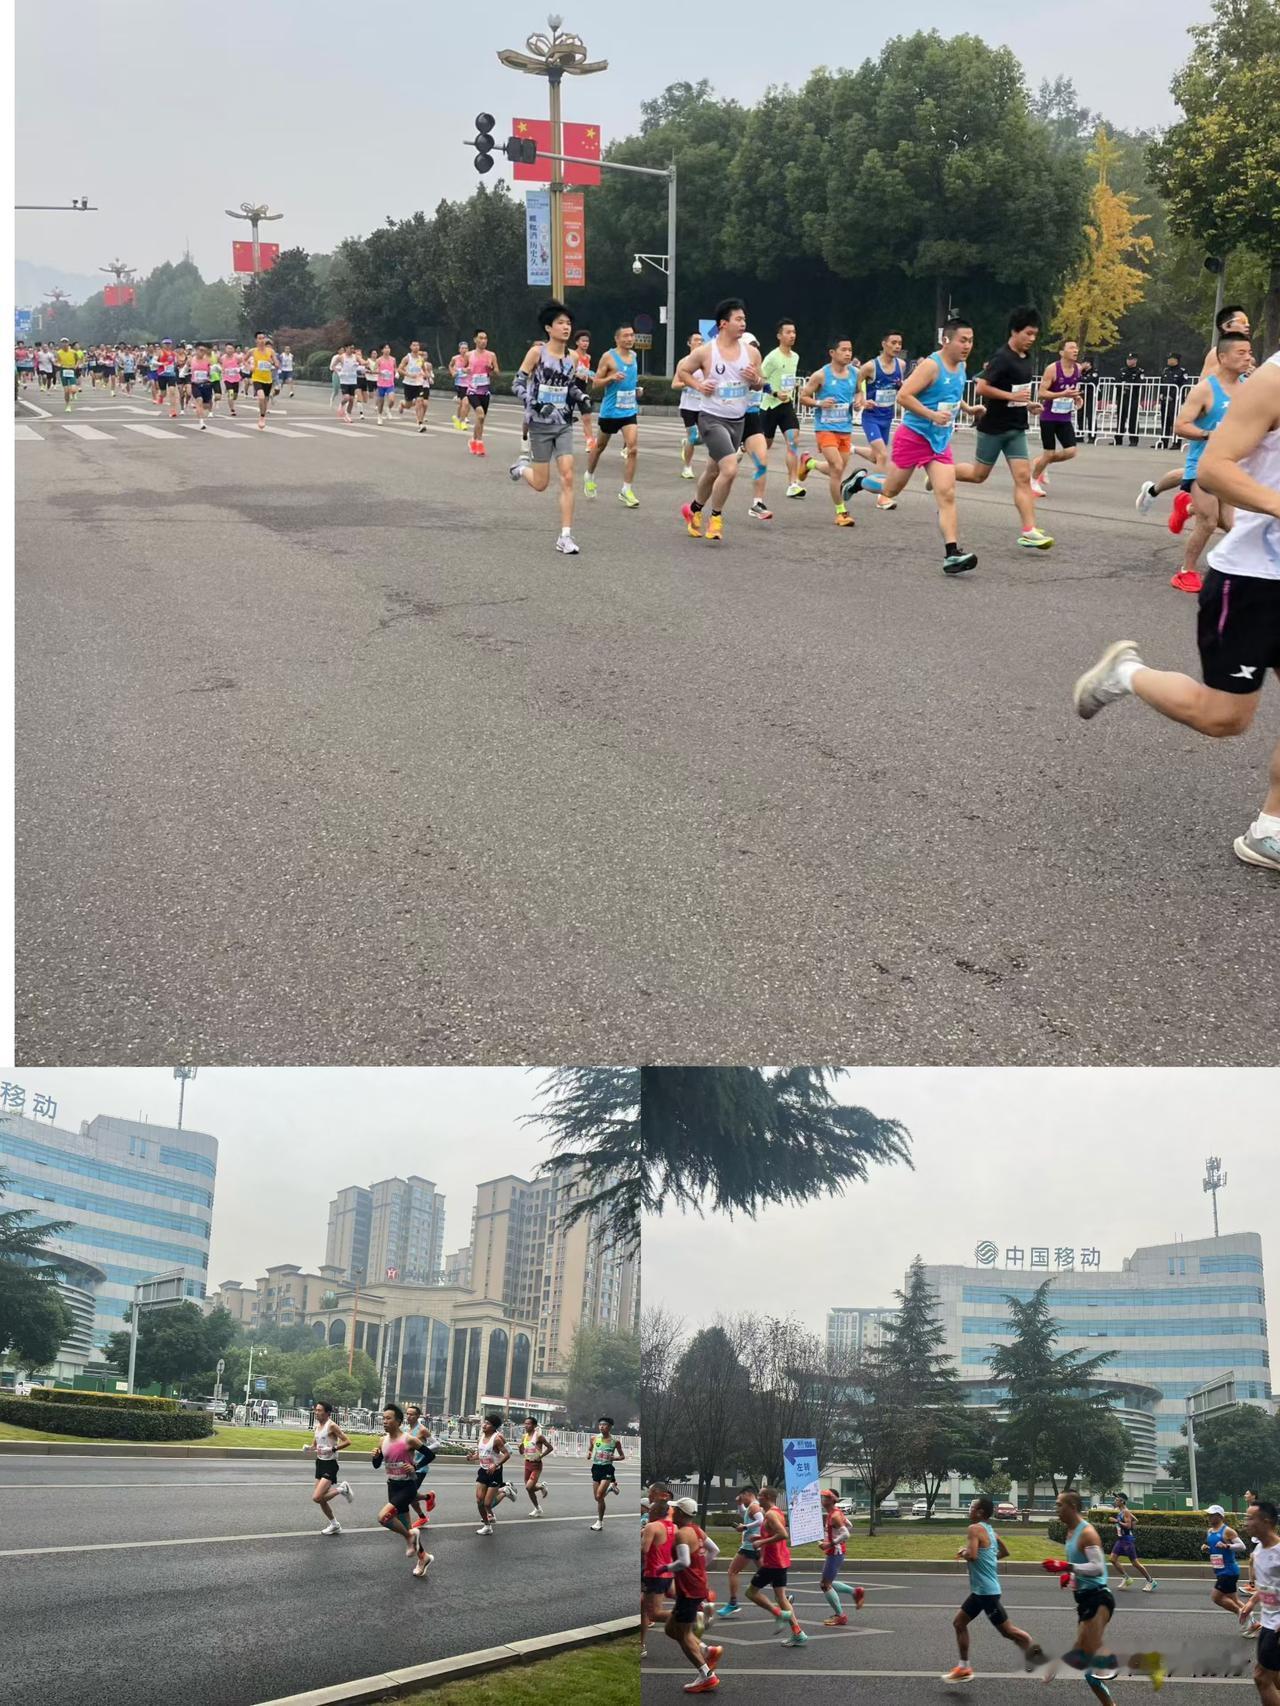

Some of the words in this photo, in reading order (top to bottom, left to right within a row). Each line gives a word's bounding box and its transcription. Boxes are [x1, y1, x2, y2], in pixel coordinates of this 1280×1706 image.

[0, 1080, 57, 1120] 移动
[1005, 1245, 1101, 1267] 中国移动
[796, 1462, 810, 1472] 左转
